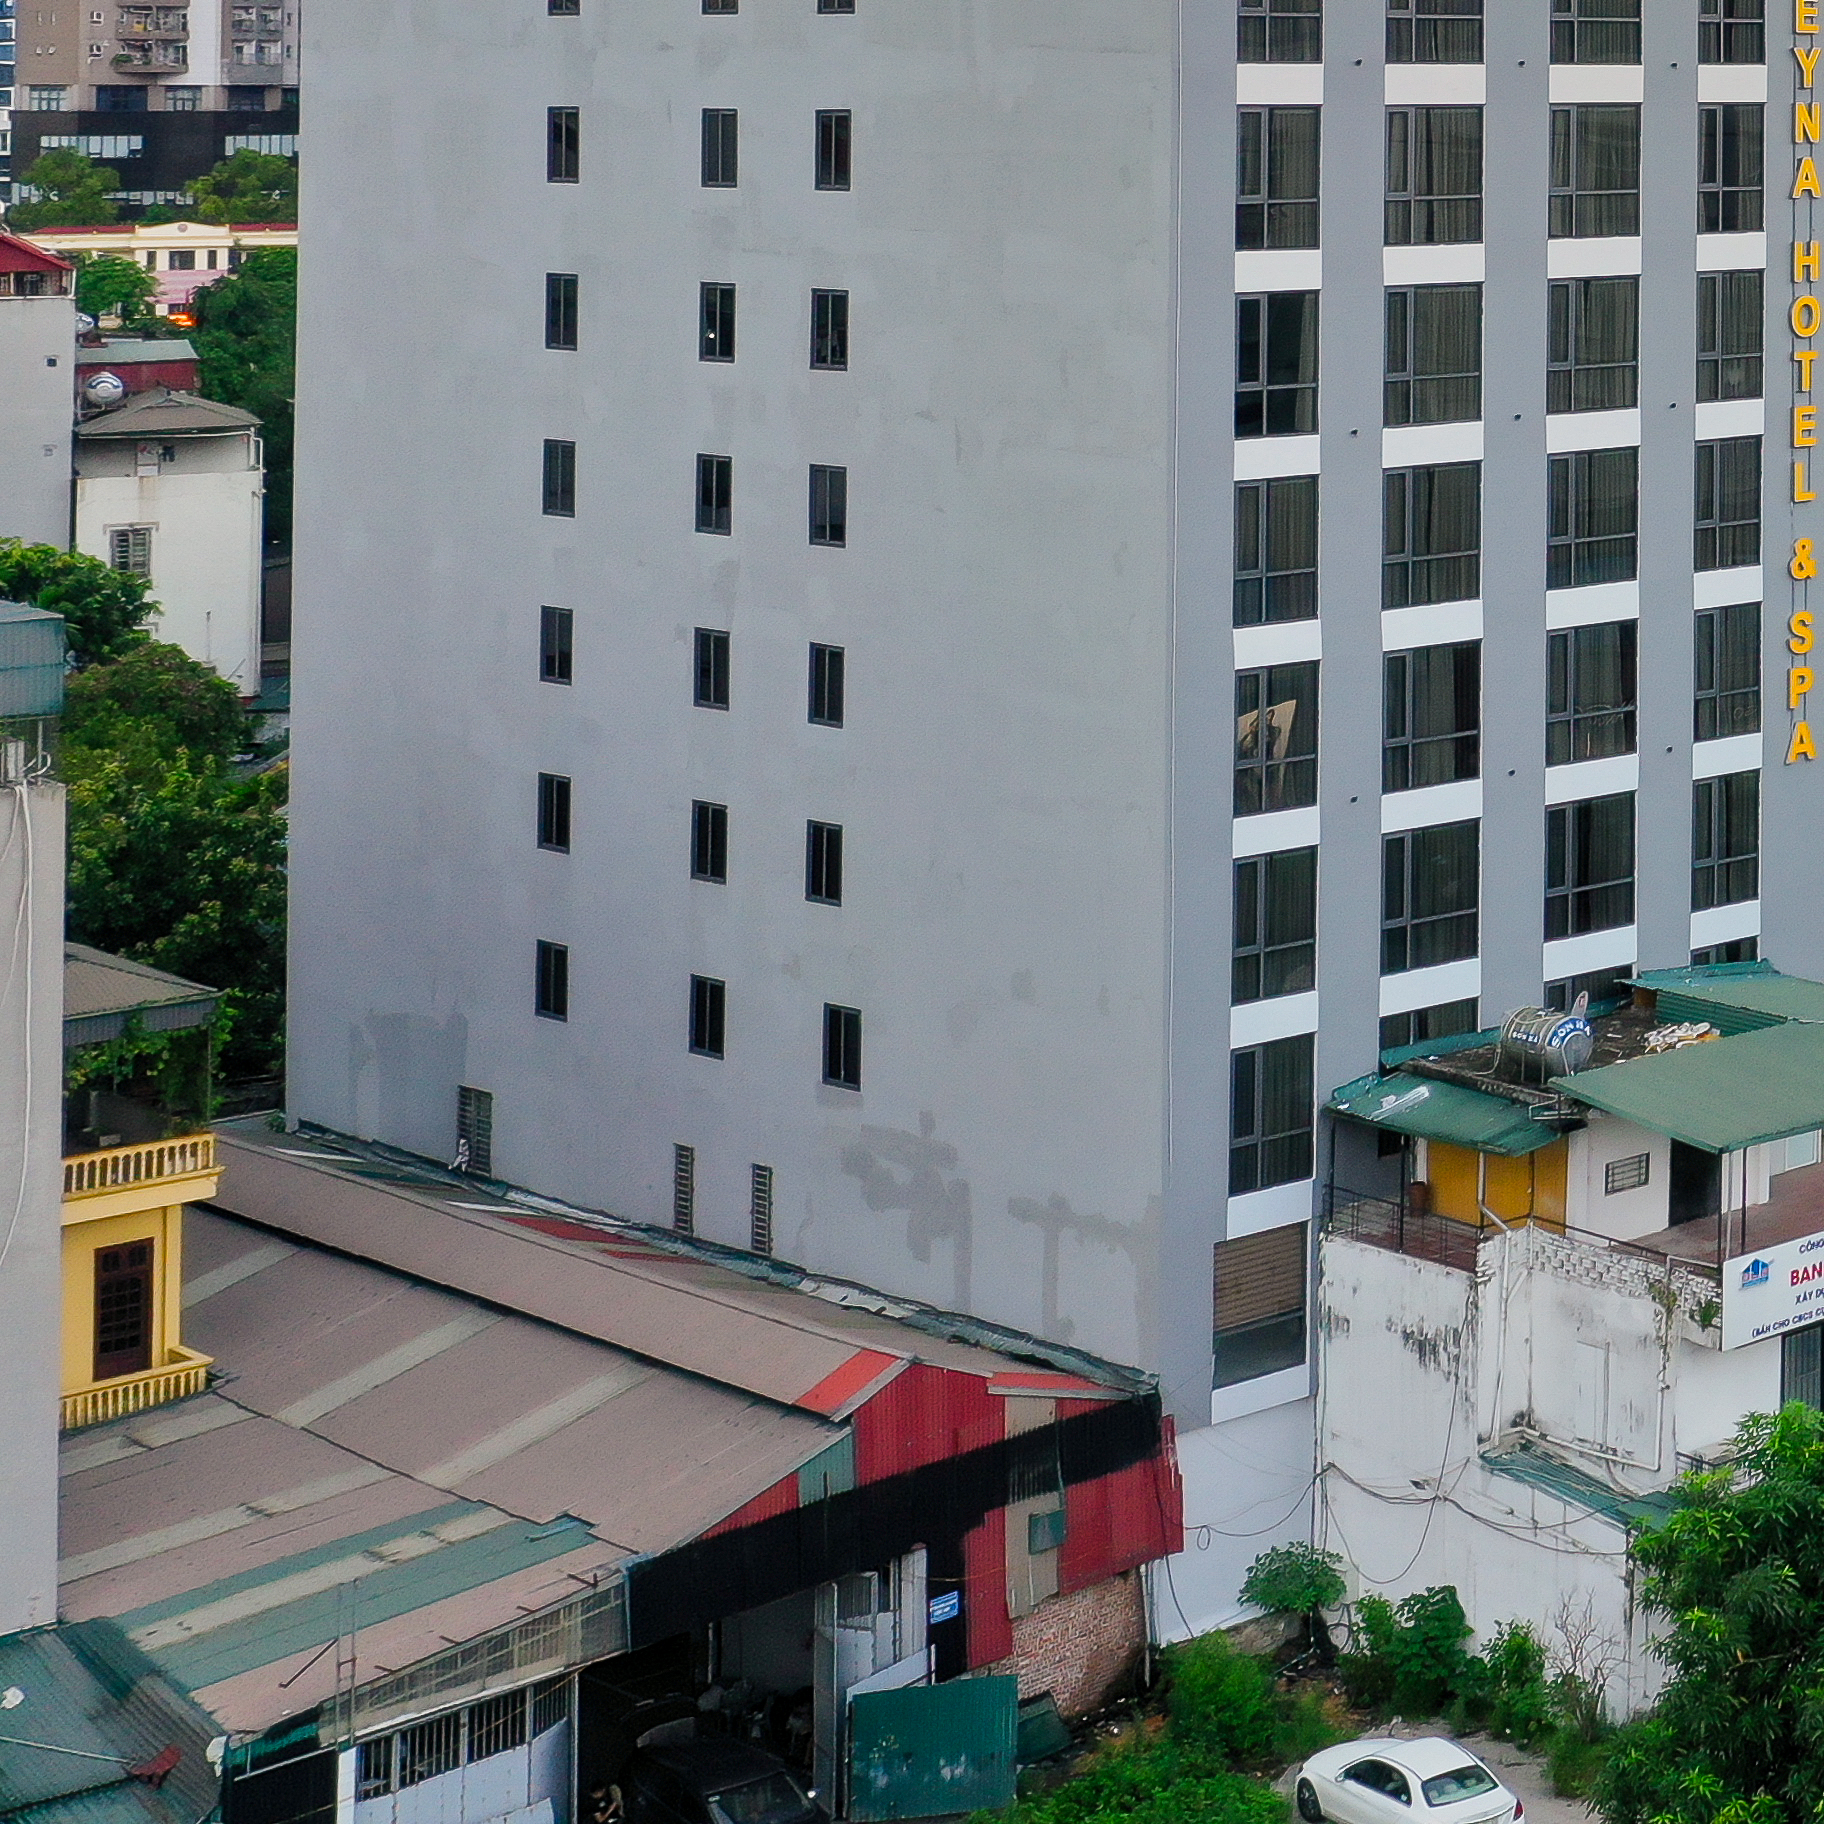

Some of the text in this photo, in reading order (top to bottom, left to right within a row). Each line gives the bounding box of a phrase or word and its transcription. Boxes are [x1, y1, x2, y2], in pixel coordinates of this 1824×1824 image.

[1790, 239, 1821, 503] HOTEL
[1789, 537, 1818, 580] &
[1786, 611, 1818, 764] SPA
[1790, 1260, 1823, 1287] BAN
